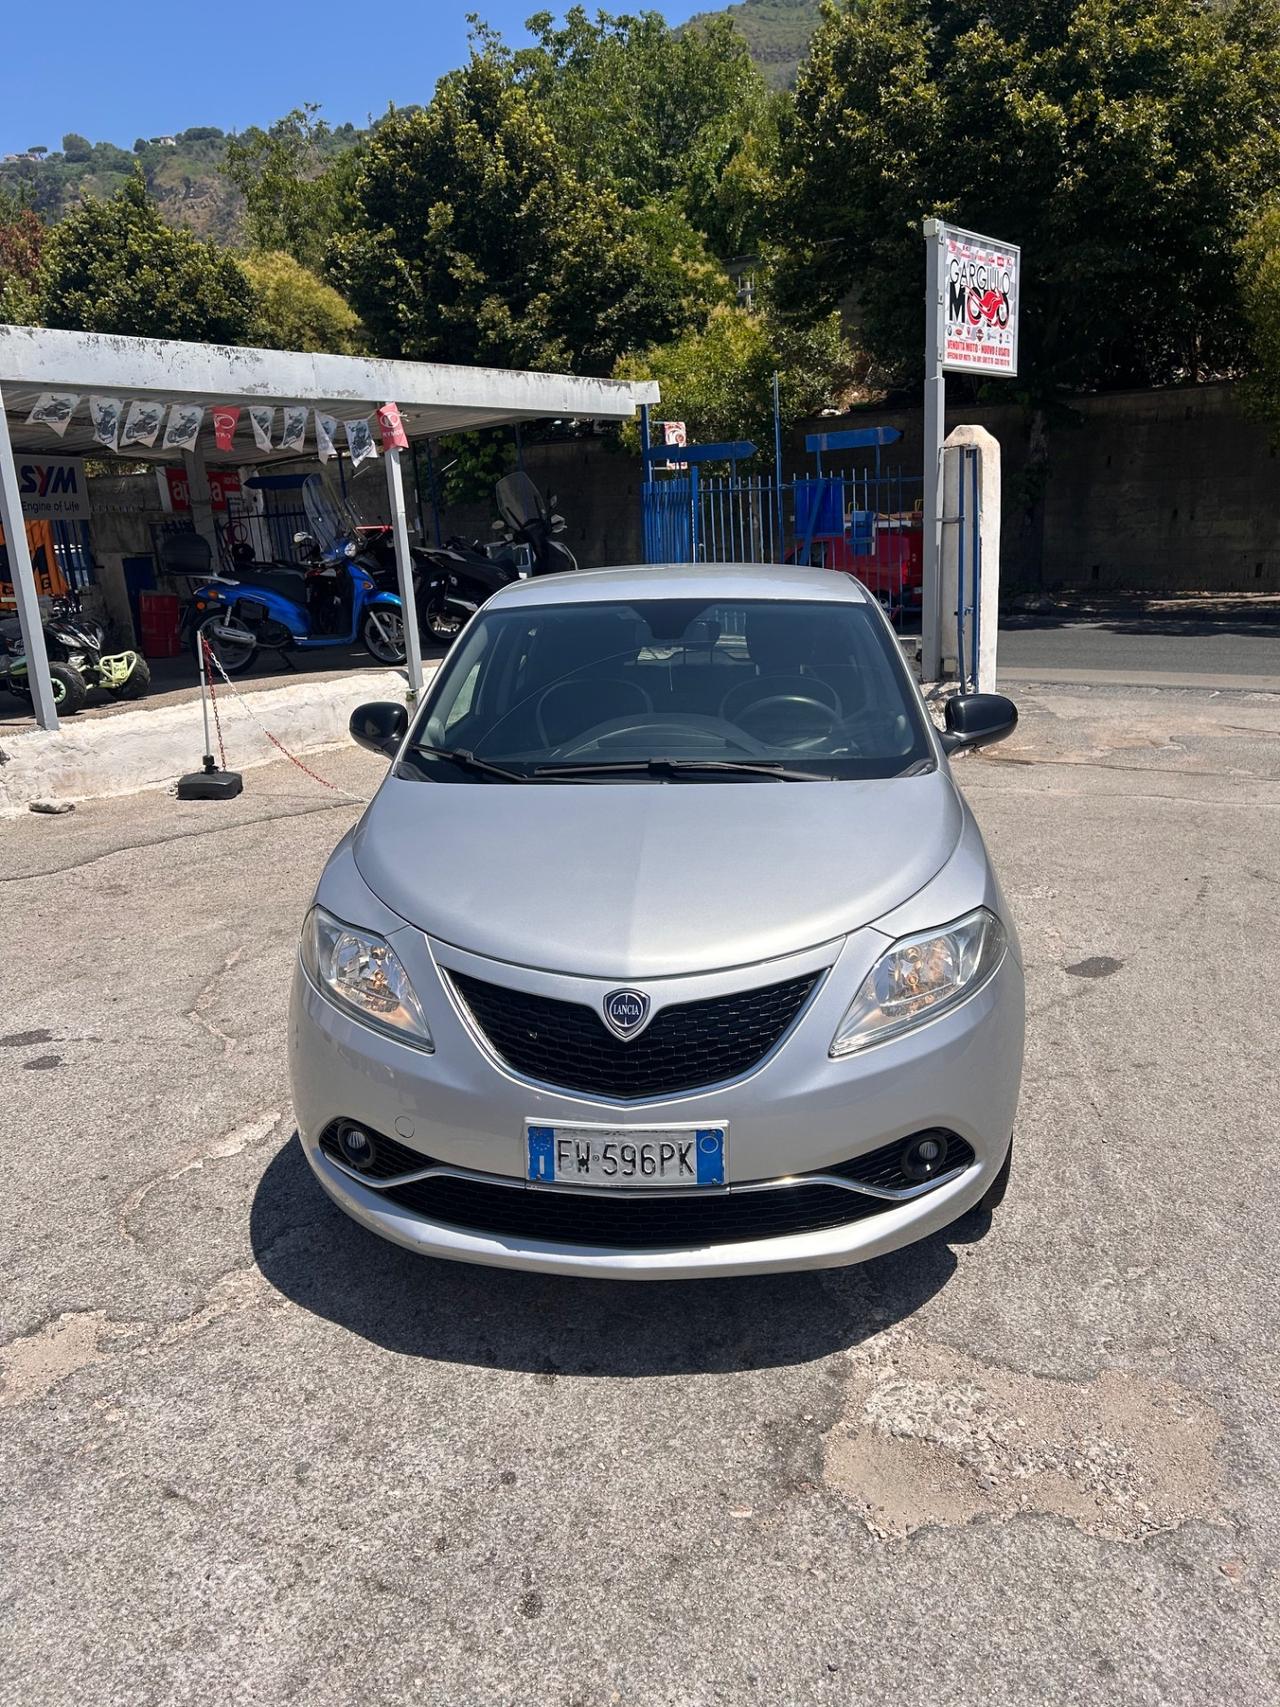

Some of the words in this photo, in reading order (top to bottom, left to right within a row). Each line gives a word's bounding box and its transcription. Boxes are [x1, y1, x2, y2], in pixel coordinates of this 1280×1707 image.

[950, 259, 1010, 294] GARGIULO
[20, 465, 78, 497] SYM
[22, 501, 51, 514] Engine
[54, 501, 63, 512] of
[64, 501, 80, 513] Life
[613, 1004, 639, 1015] LANCIA
[557, 1139, 591, 1174] FW
[602, 1140, 695, 1177] 596PK
